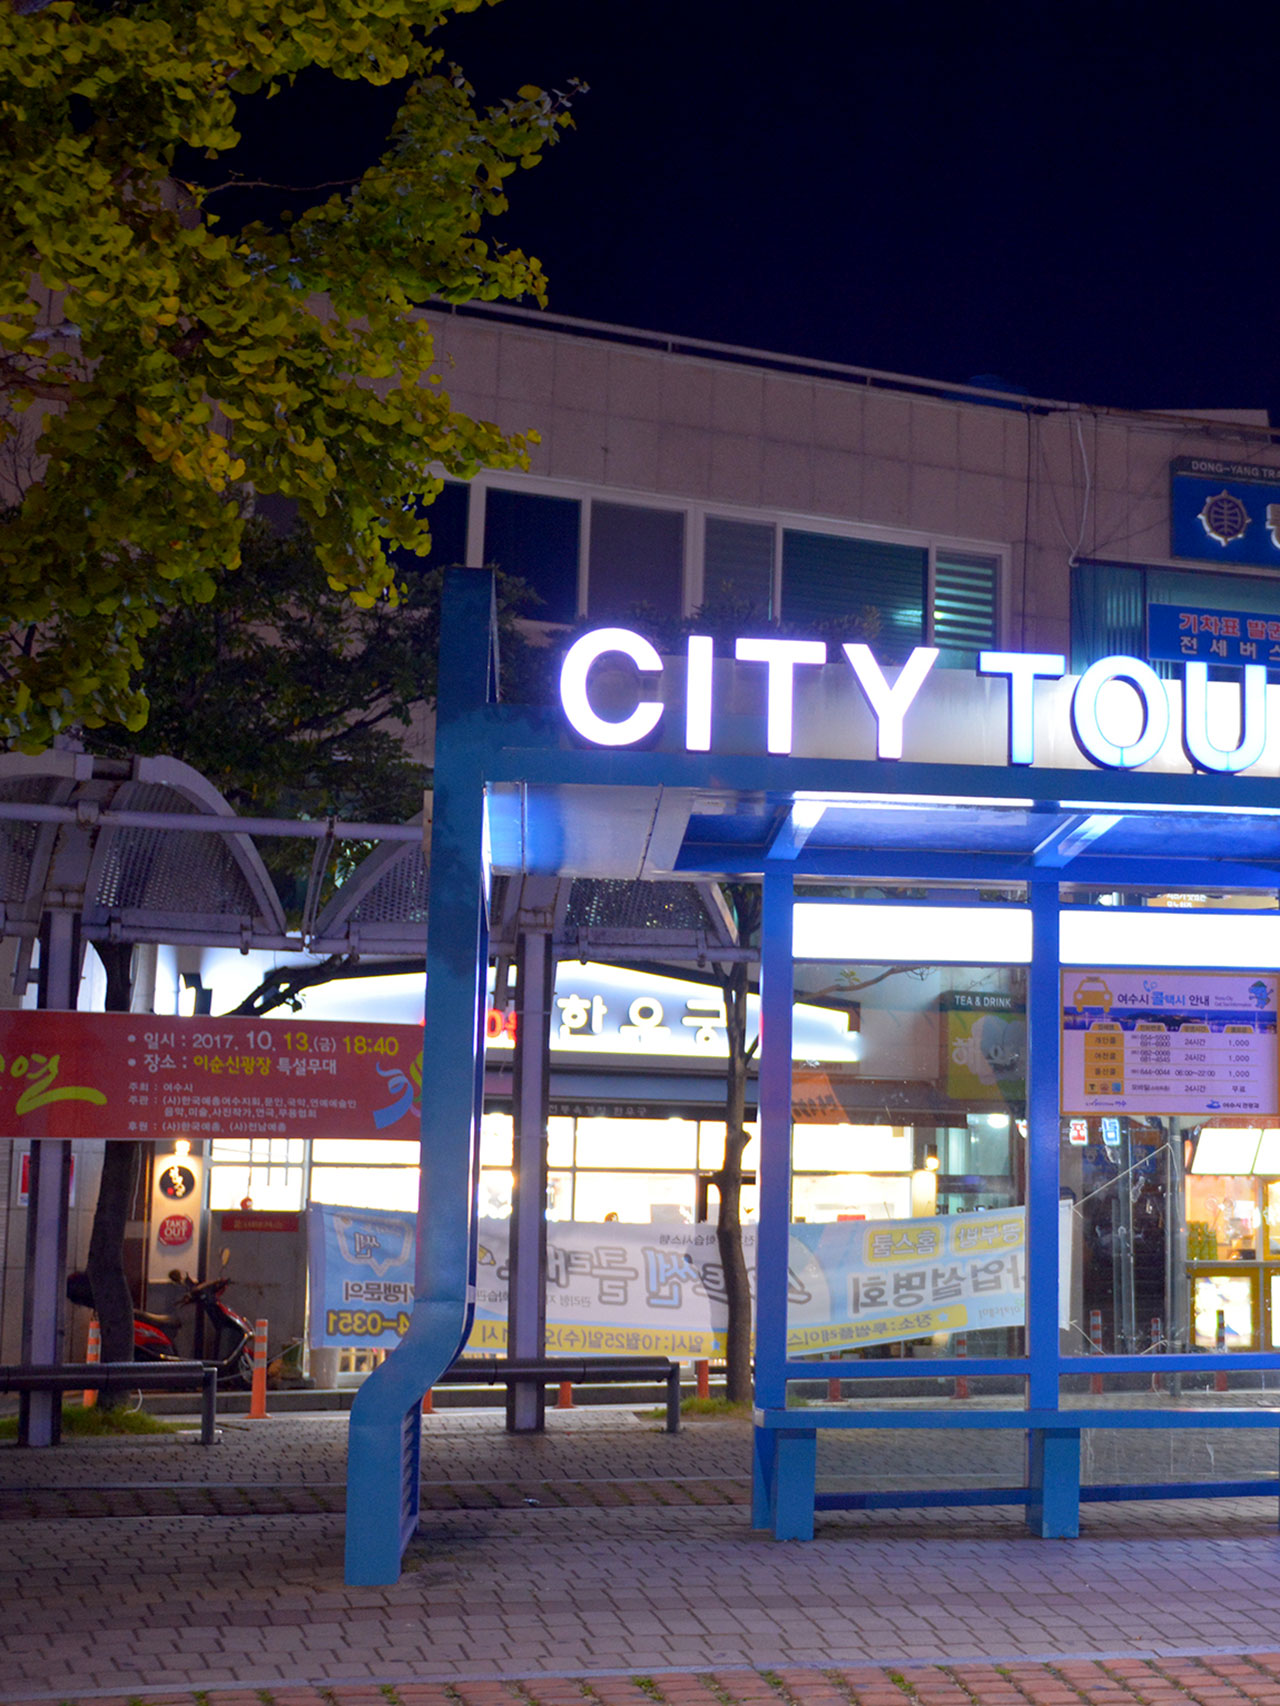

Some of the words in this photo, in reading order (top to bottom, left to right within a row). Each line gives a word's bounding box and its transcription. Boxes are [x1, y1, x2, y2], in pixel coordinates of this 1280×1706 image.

[1191, 460, 1260, 477] DONG-YANG
[1179, 613, 1240, 637] 기차표
[560, 627, 938, 760] CITY
[955, 995, 973, 1005] TEA
[983, 997, 1011, 1008] DRINK
[1117, 993, 1149, 1005] 여수시
[1189, 994, 1210, 1007] 안내
[144, 1032, 175, 1050] 일시
[192, 1033, 239, 1051] 2017.
[343, 1035, 399, 1056] 18:40
[1184, 1038, 1206, 1047] 24시간
[1228, 1039, 1250, 1048] 1,000
[1184, 1053, 1206, 1062] 24시간
[1228, 1054, 1250, 1063] 1,000
[144, 1054, 177, 1073] 장소
[193, 1055, 271, 1076] 이순신광장
[276, 1057, 337, 1076] 특설무대
[1228, 1070, 1250, 1078] 1,000
[163, 1082, 194, 1093] 여수시
[1184, 1085, 1206, 1093] 24시간
[164, 1219, 188, 1229] TAKE
[164, 1228, 188, 1238] OUT
